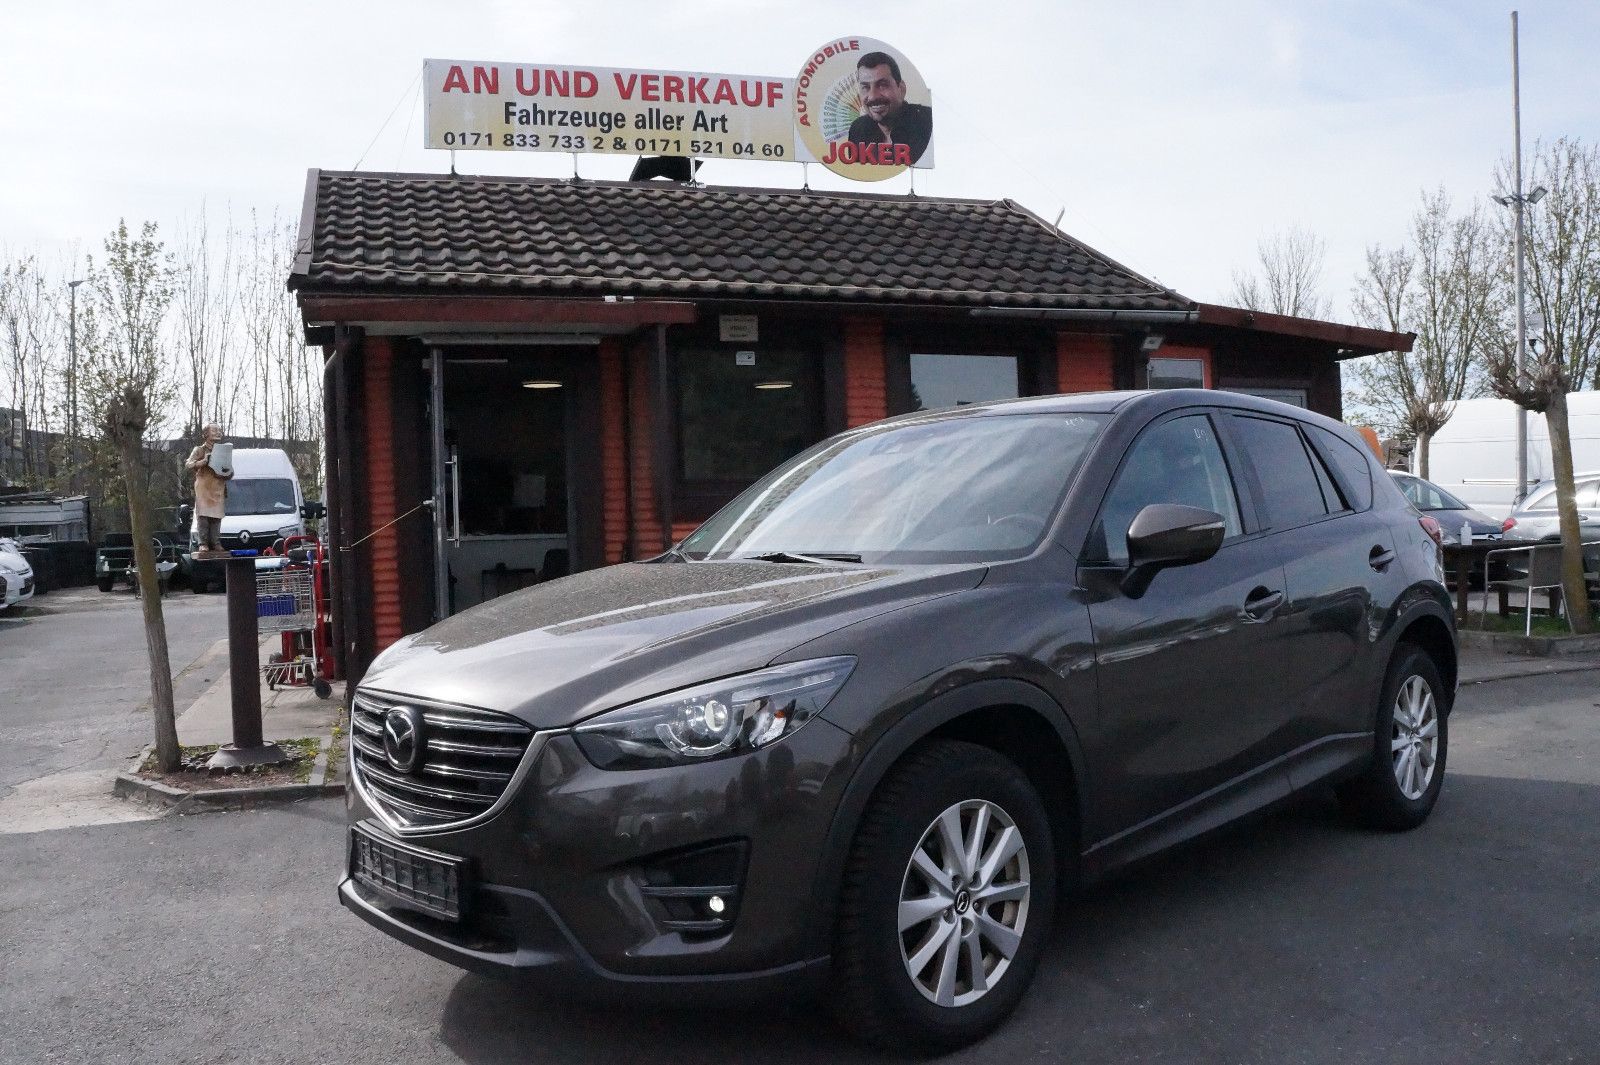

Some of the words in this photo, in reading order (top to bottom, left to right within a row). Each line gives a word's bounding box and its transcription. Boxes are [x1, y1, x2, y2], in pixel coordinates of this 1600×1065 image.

[442, 65, 499, 95] AN
[515, 68, 599, 98] UND
[613, 72, 784, 108] VERKAUF
[797, 40, 859, 127] AUTOMOBILE
[504, 101, 626, 134] Fahrzeuge
[634, 108, 685, 131] aller
[692, 109, 728, 133] Art
[443, 131, 493, 146] 0171
[503, 134, 540, 148] 833
[549, 135, 585, 149] 733
[593, 136, 604, 150] 2
[612, 137, 627, 151] &
[634, 138, 681, 153] 0171
[690, 141, 723, 154] 521
[732, 142, 755, 155] 04
[762, 144, 784, 157] 60
[822, 141, 912, 166] JOKER
